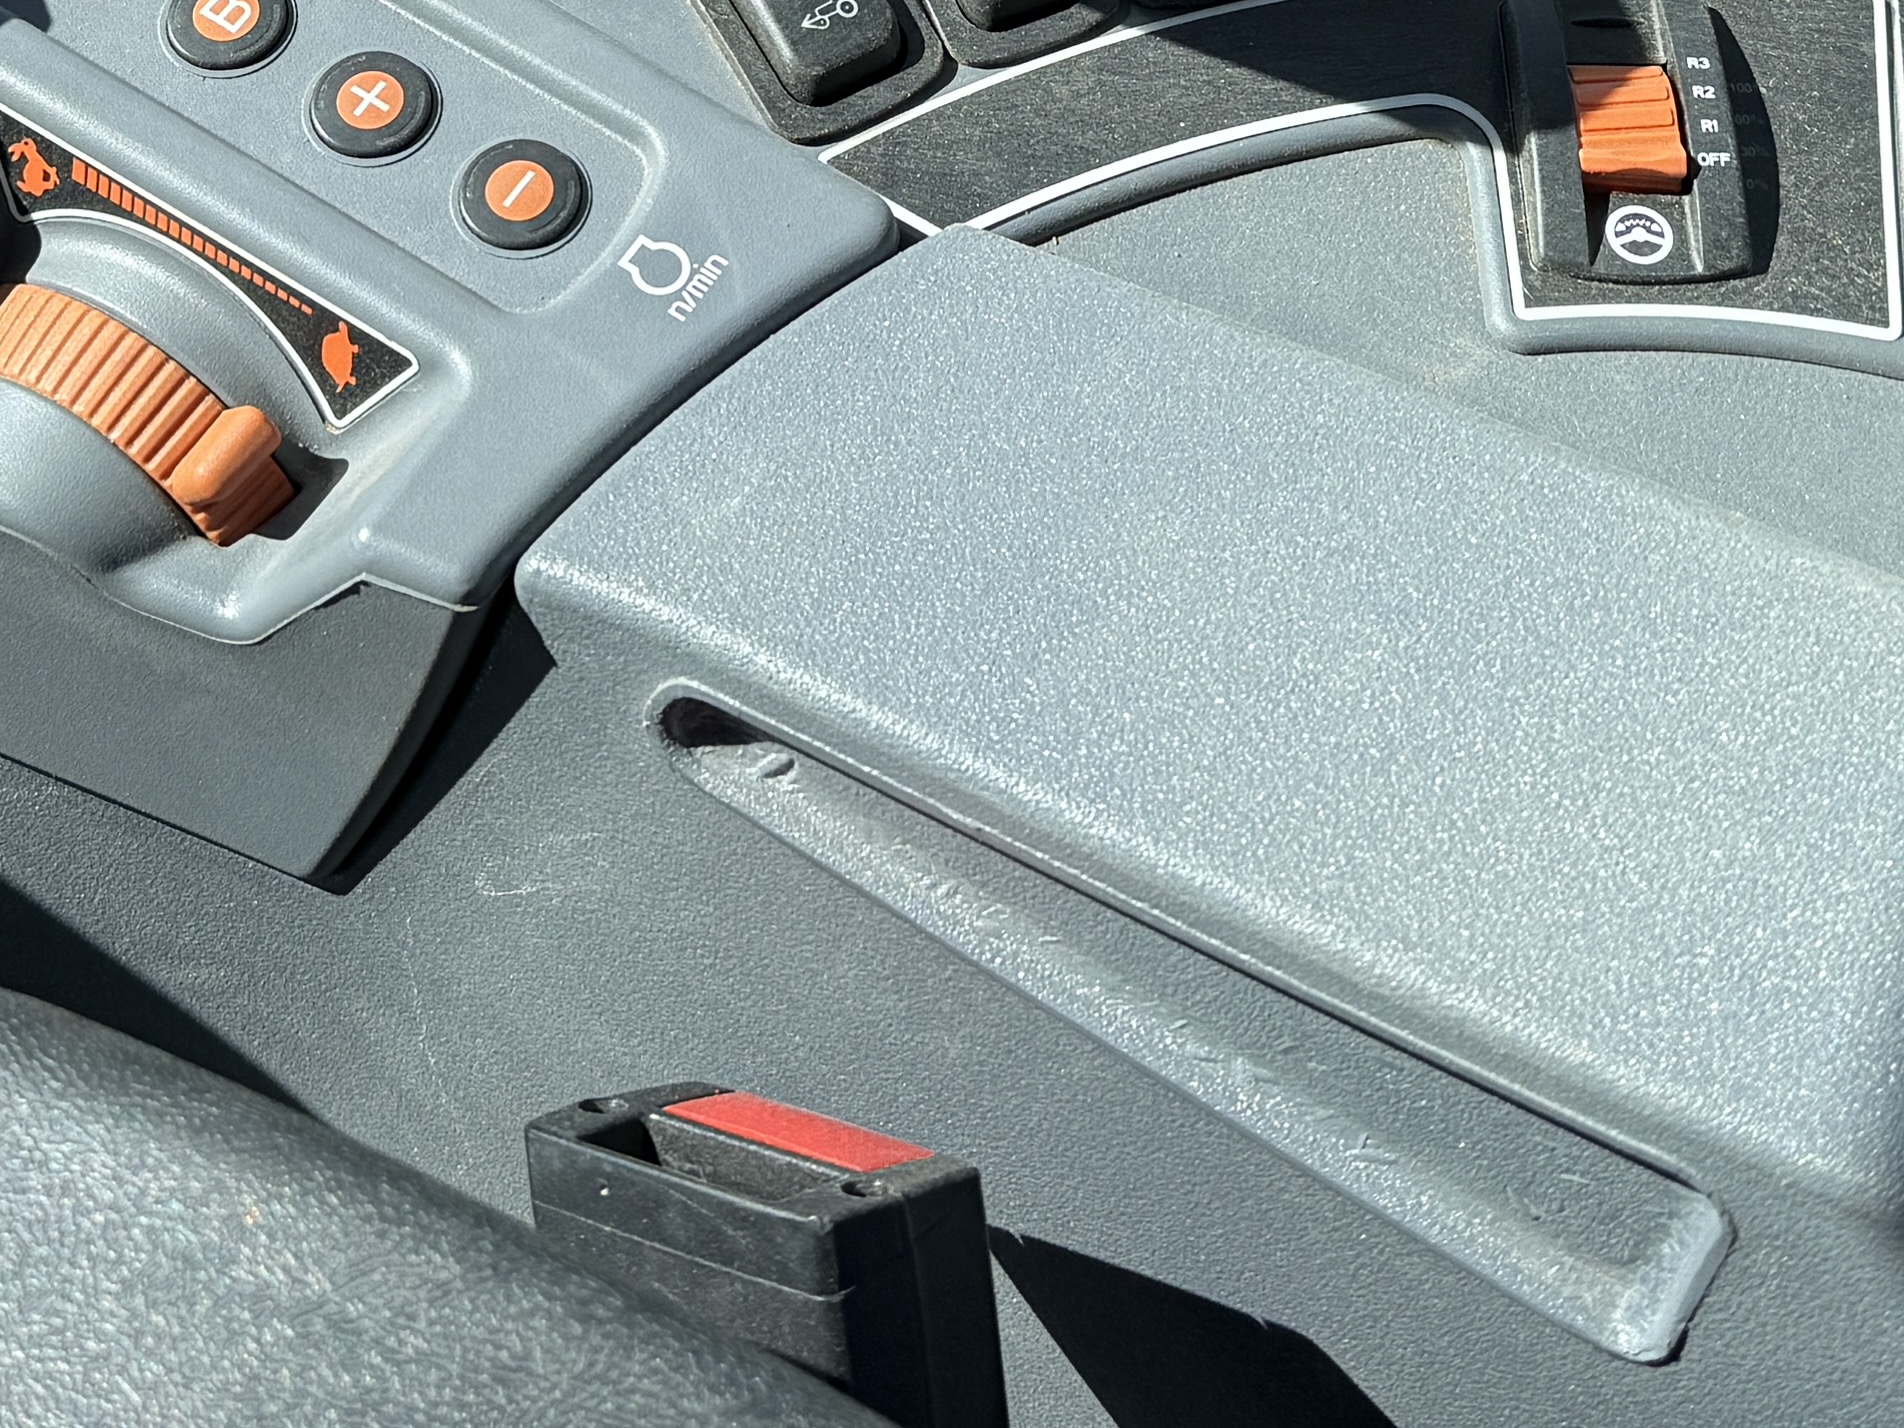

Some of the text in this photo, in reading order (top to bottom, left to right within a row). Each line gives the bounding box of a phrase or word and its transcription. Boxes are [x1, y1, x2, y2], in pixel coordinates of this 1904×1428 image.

[1686, 56, 1711, 70] R3
[1692, 85, 1717, 99] R2
[1700, 118, 1719, 133] R1
[1697, 151, 1732, 167] OFF
[667, 252, 730, 322] n/min
